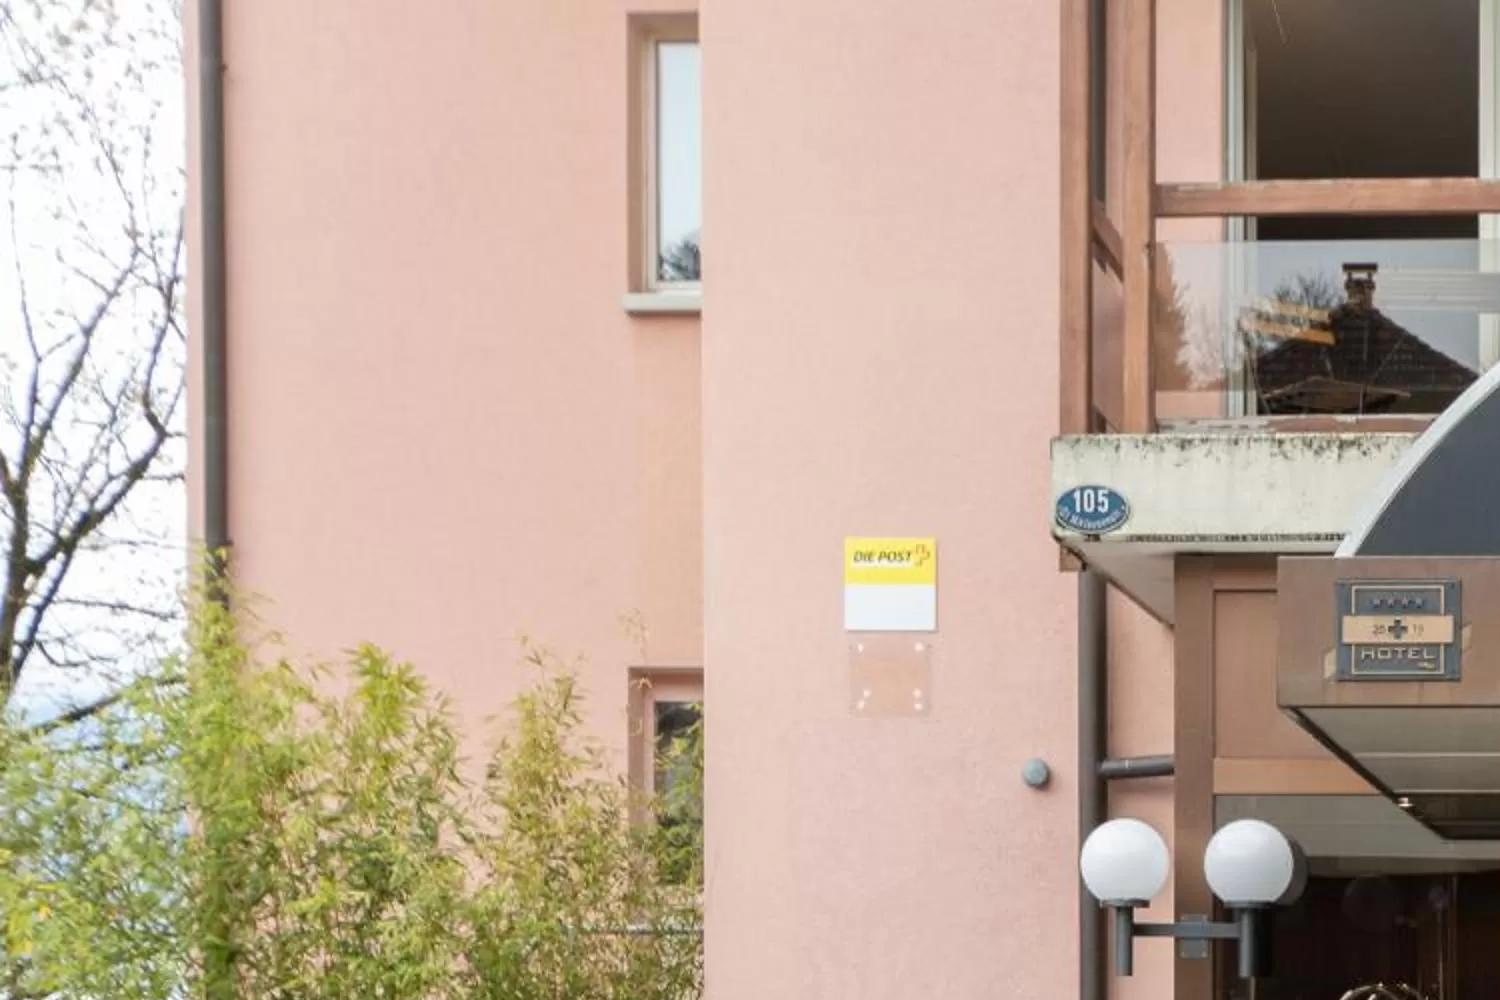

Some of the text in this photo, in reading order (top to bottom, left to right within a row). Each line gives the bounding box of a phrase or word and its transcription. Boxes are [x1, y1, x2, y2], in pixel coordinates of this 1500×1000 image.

[1074, 488, 1109, 513] 105
[853, 550, 912, 564] DIE POST
[1361, 647, 1437, 660] HOTEL
